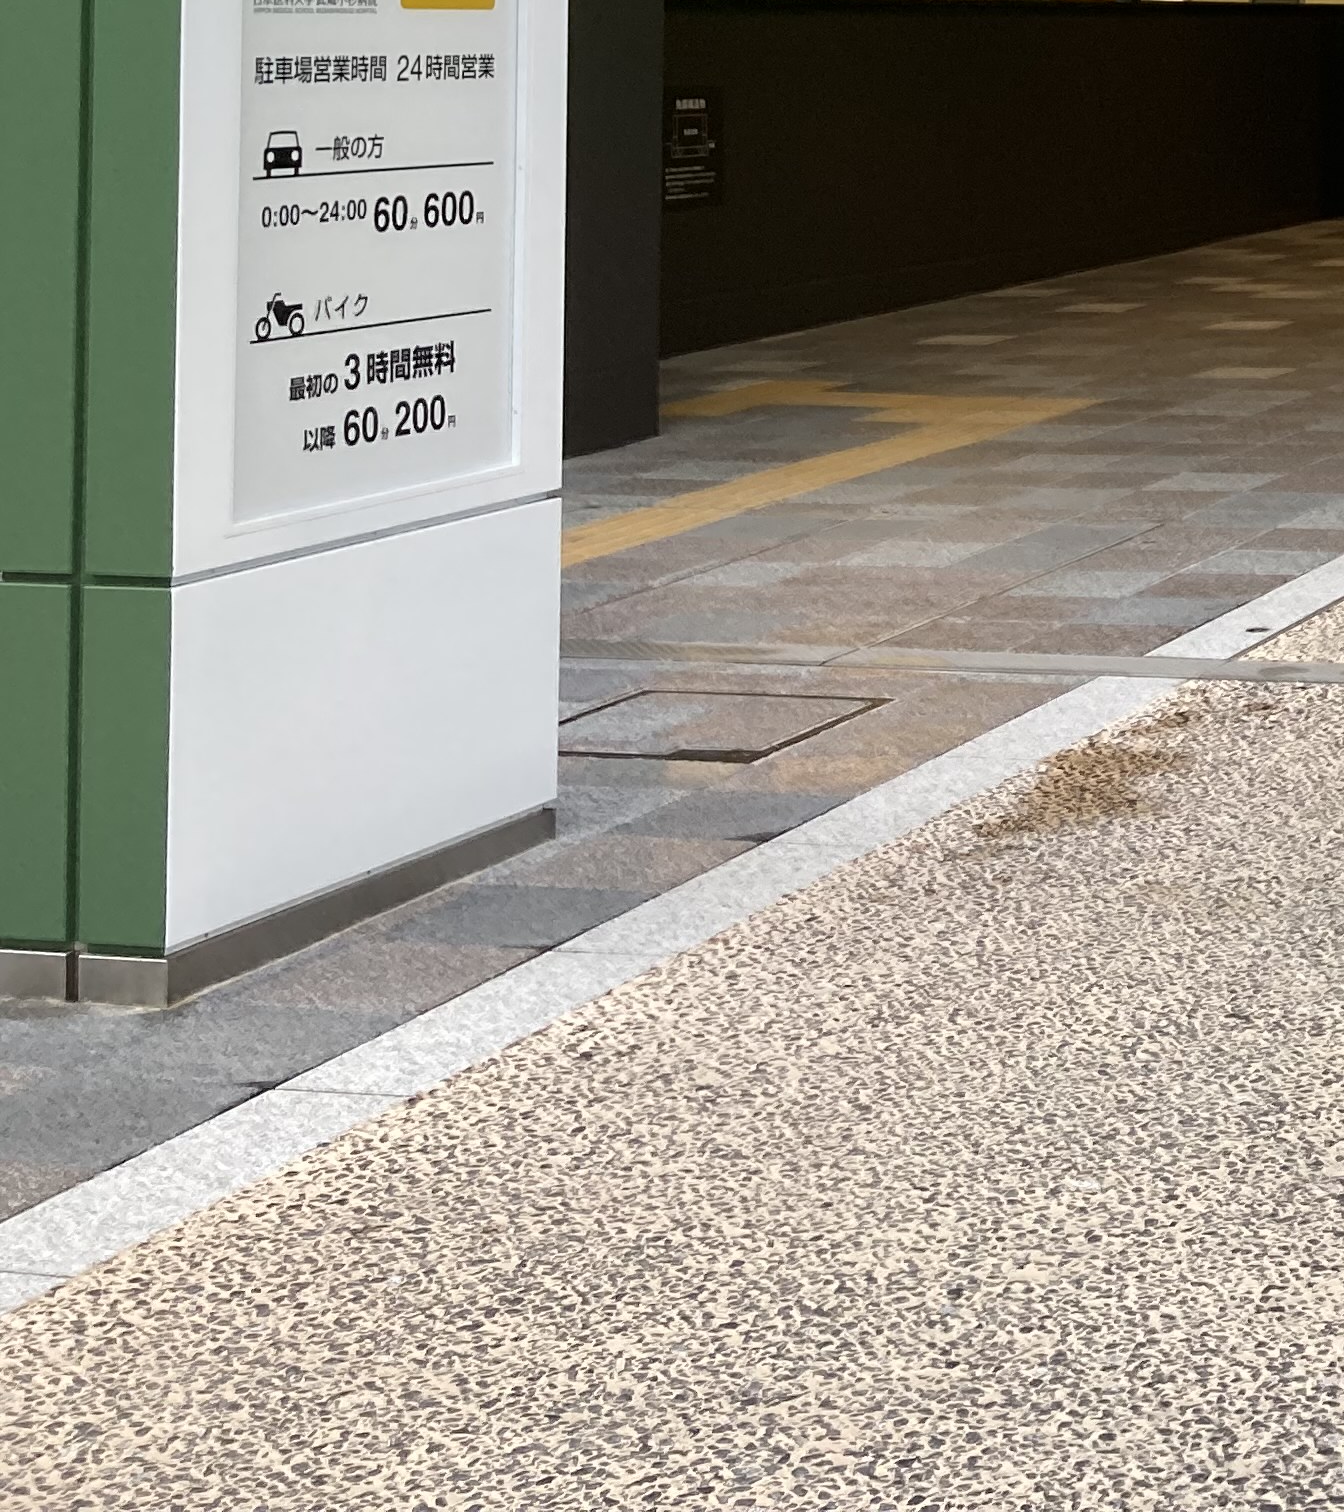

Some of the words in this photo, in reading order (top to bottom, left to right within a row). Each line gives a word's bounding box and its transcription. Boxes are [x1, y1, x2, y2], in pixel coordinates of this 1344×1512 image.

[254, 56, 387, 85] 駐車場営業時間
[396, 53, 495, 82] 24時間営業
[315, 134, 385, 161] 一般の方
[314, 293, 369, 322] バイク
